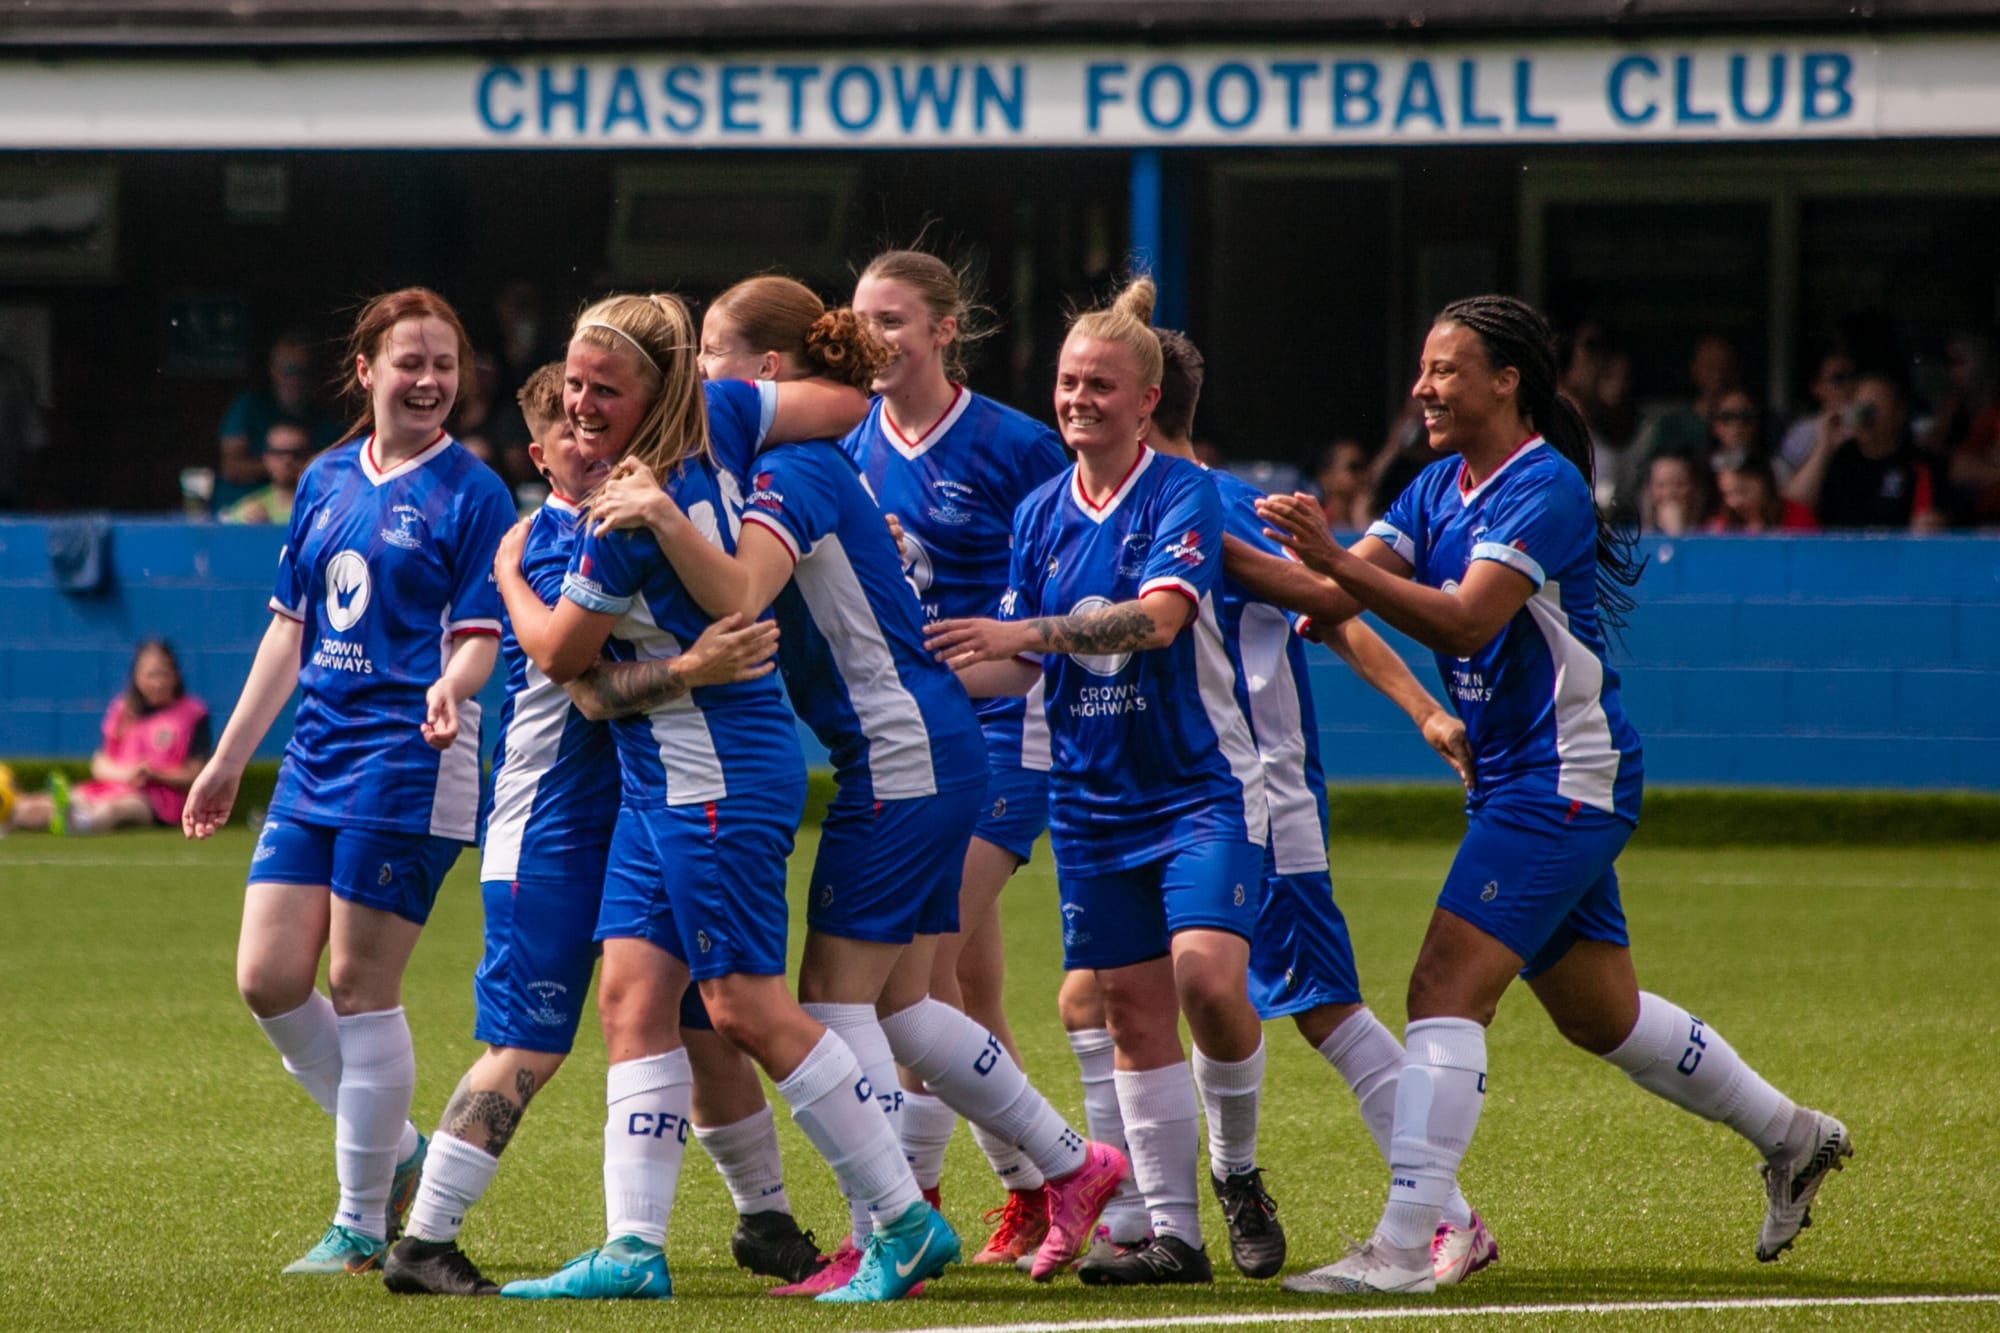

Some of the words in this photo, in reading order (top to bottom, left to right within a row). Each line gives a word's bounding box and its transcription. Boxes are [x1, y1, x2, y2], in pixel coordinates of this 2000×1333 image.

[477, 62, 1024, 134] CHASETOWN
[1087, 56, 1557, 131] FOOTBALL
[1608, 52, 1854, 126] CLUB
[321, 639, 363, 658] ROWN
[1070, 697, 1147, 717] HIGHWAS
